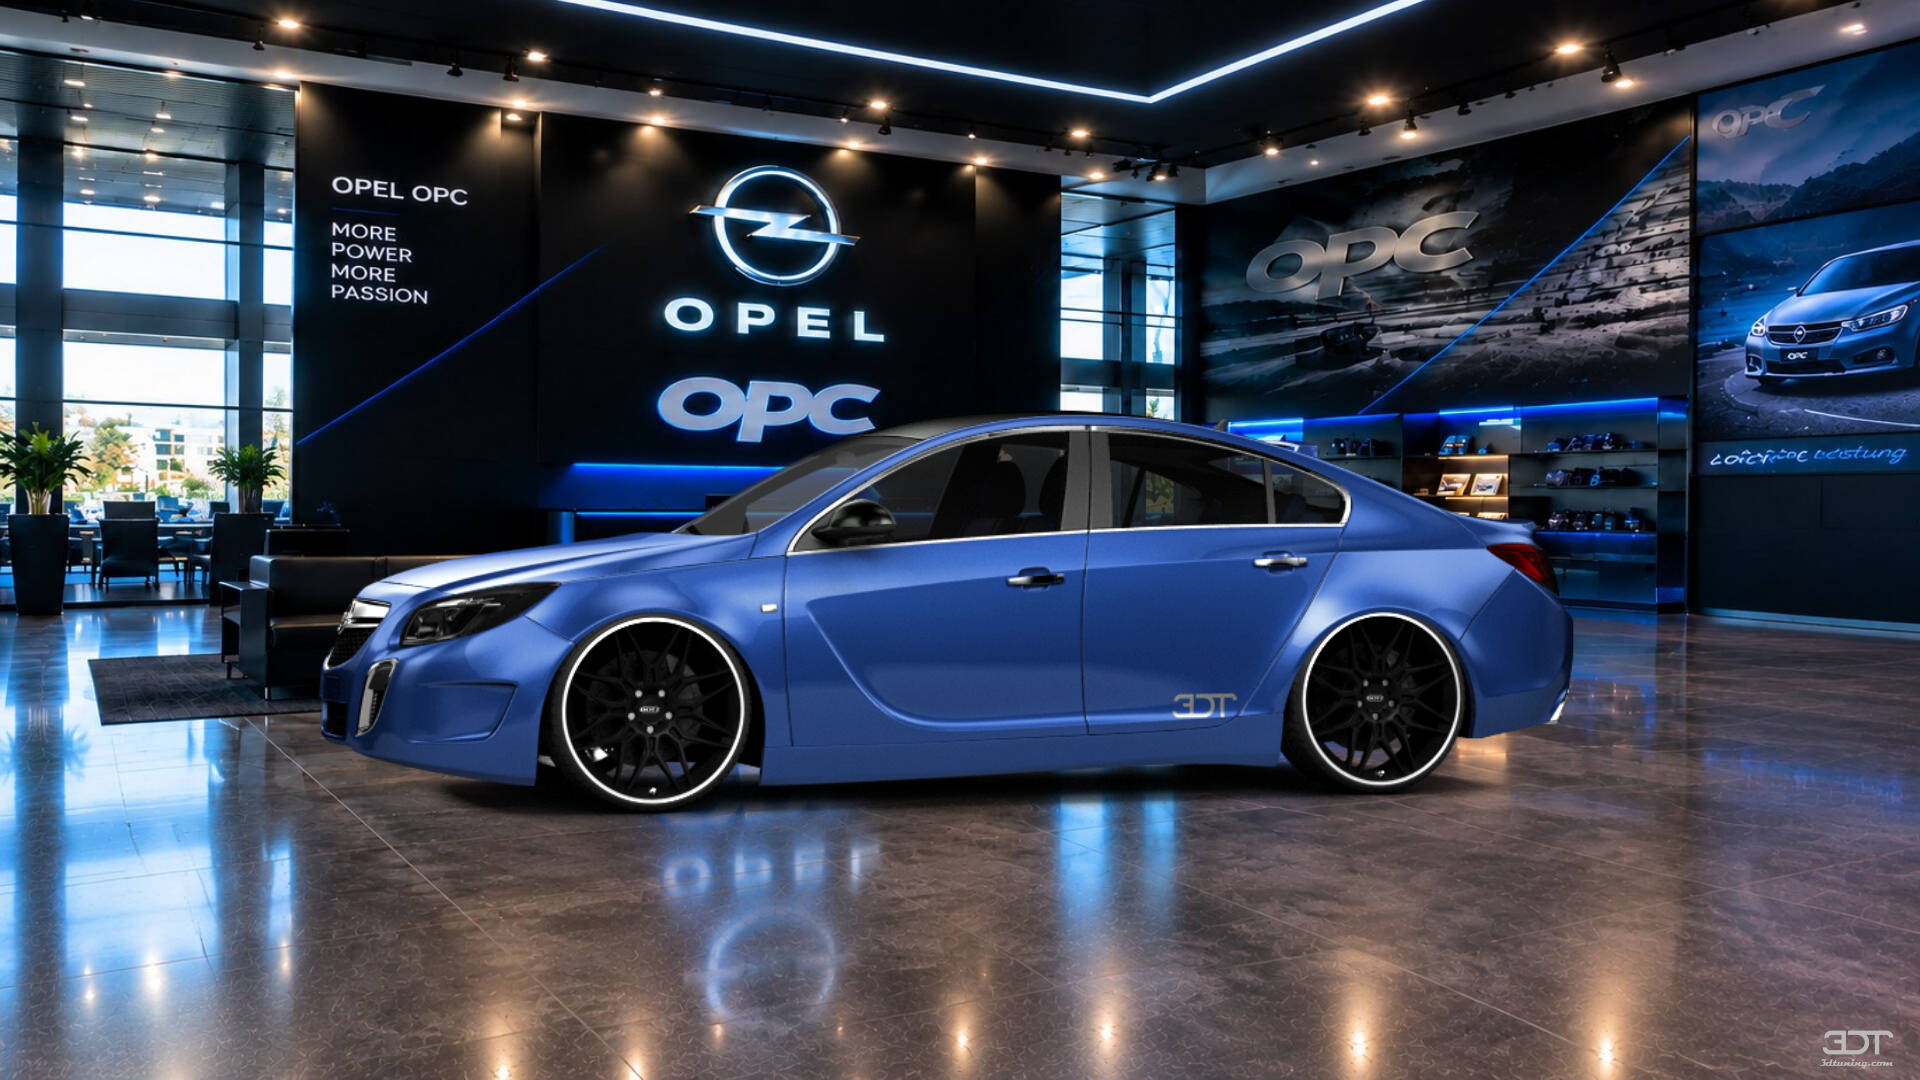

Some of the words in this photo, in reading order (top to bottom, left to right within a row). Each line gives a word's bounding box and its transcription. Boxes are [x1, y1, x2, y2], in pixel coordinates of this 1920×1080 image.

[332, 176, 404, 200] OPEL
[412, 185, 468, 206] OPC
[332, 222, 396, 242] MORE
[332, 242, 412, 263] POWER
[1246, 211, 1479, 300] OPC
[331, 263, 396, 283] MORE
[331, 284, 428, 305] PASSION
[664, 297, 885, 342] OPEL
[657, 376, 881, 443] OPC
